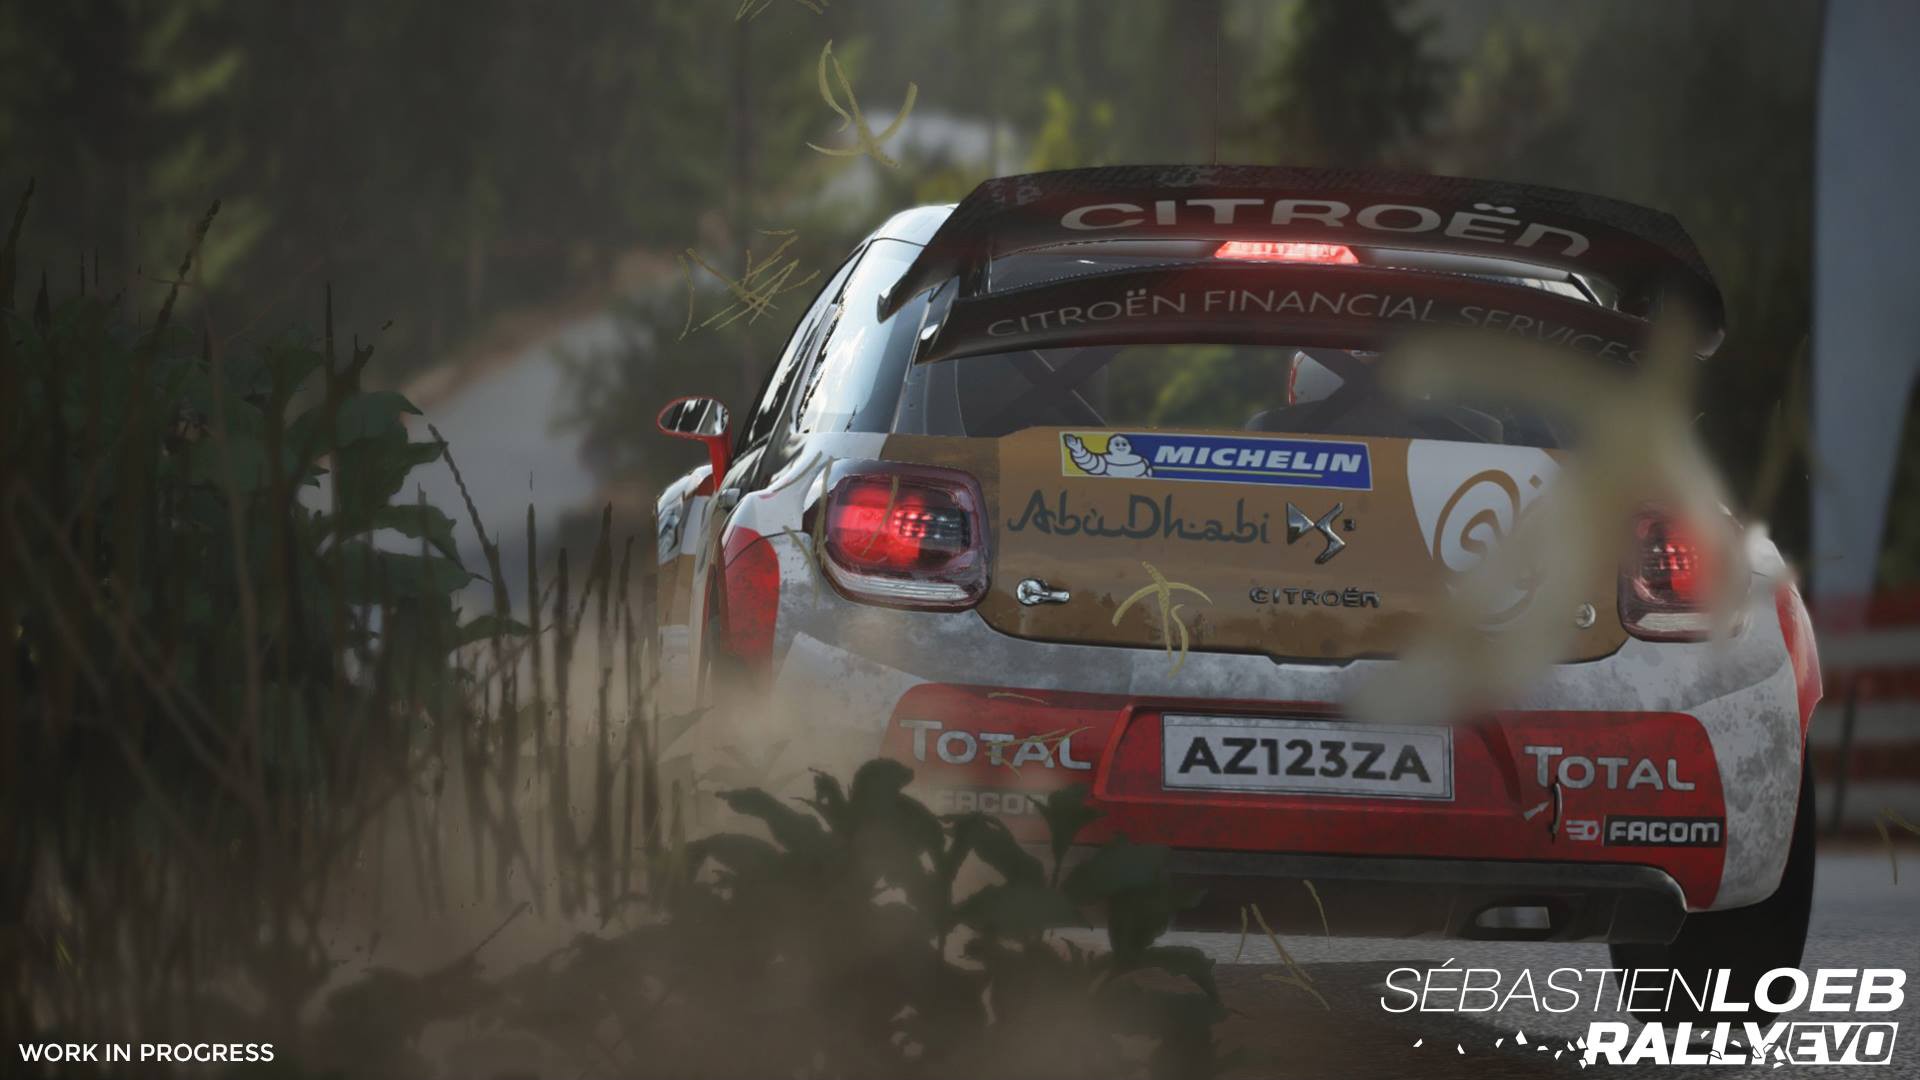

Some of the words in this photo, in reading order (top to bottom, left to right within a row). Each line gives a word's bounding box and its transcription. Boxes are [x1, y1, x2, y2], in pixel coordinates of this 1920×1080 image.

[987, 289, 1186, 338] CITROËN
[1204, 289, 1438, 324] FINANCIAL
[1455, 305, 1643, 369] SERVICES
[1155, 445, 1362, 473] MICHELIN
[900, 719, 1092, 770] TOTAL
[1177, 737, 1432, 784] AZ123ZA
[1524, 745, 1696, 791] TOTAL
[1609, 820, 1720, 843] FACOM
